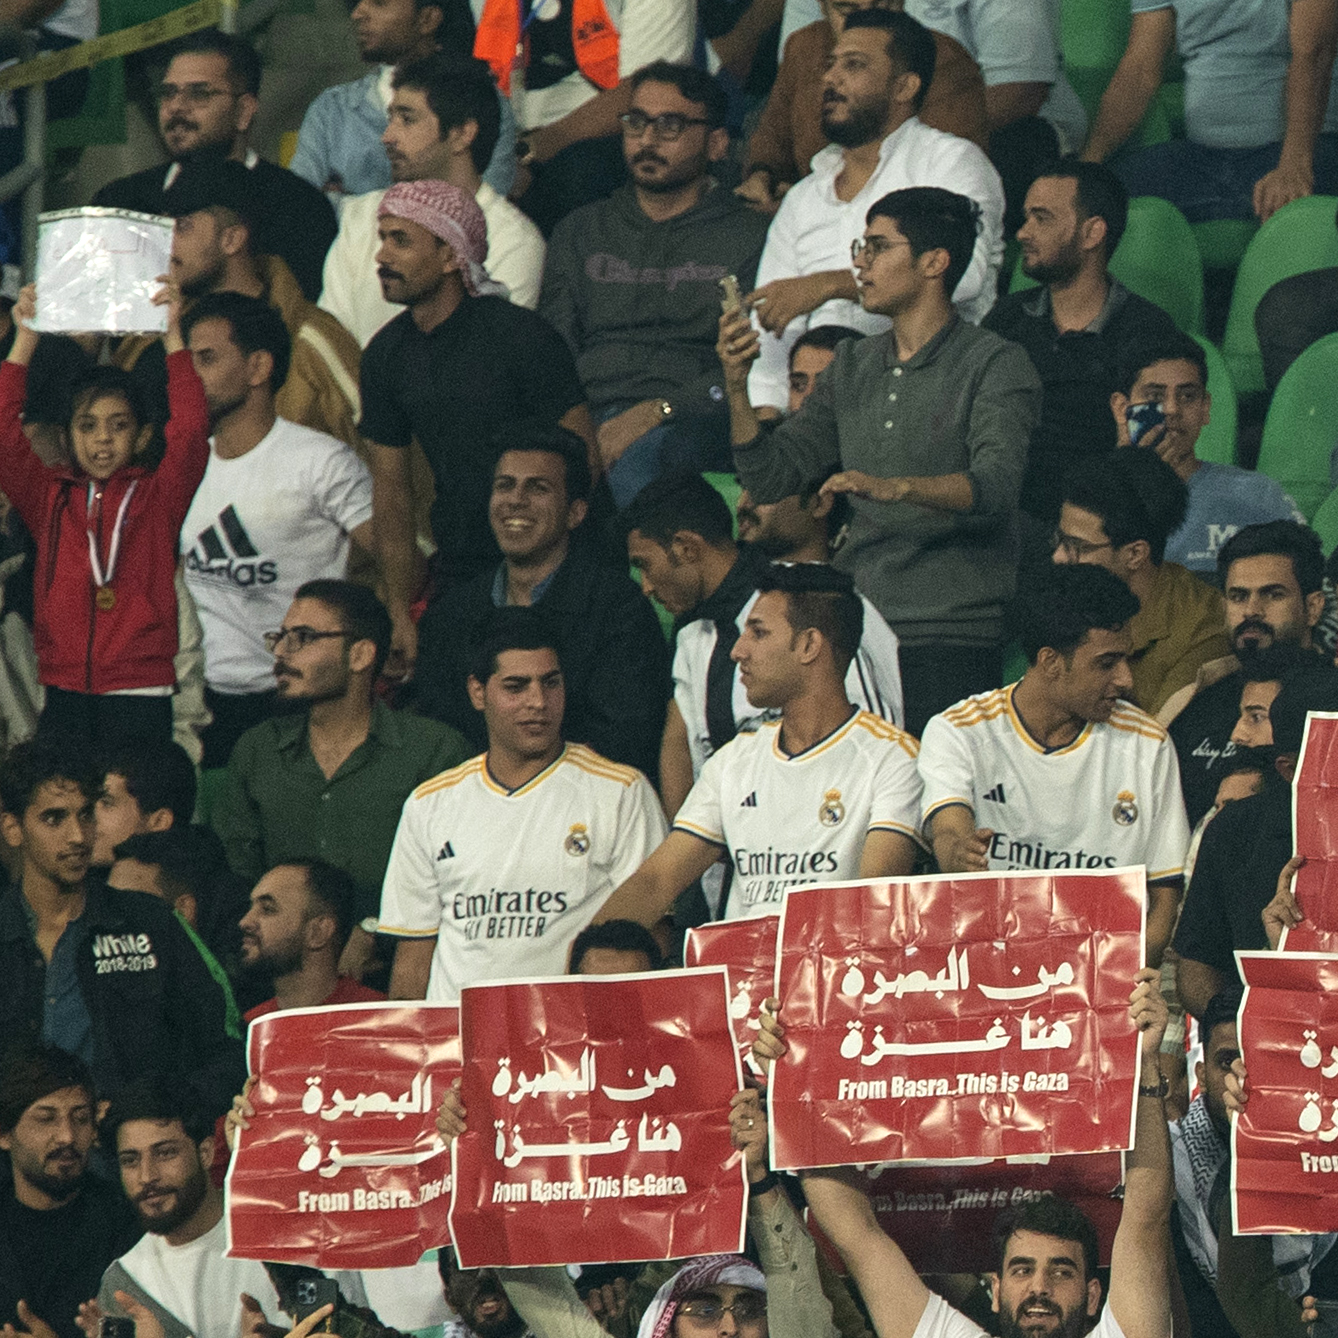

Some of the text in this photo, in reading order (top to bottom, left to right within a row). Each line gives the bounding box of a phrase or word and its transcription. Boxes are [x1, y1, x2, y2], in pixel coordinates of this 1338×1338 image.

[735, 846, 838, 876] Emirates
[989, 833, 1117, 870] Emirates
[452, 887, 567, 920] Emirates
[486, 916, 546, 939] BETTER
[841, 945, 1075, 1005] من البصرة
[1021, 1009, 1072, 1051] هنا
[492, 1046, 677, 1104] من البصرة
[838, 1078, 887, 1101] From
[1001, 1072, 1019, 1094] is
[1023, 1071, 1069, 1092] Gaza
[301, 1071, 432, 1122] البصرة
[638, 1111, 682, 1152] هنا
[298, 1190, 349, 1213] From
[622, 1174, 640, 1198] is
[643, 1173, 688, 1196] Gaza
